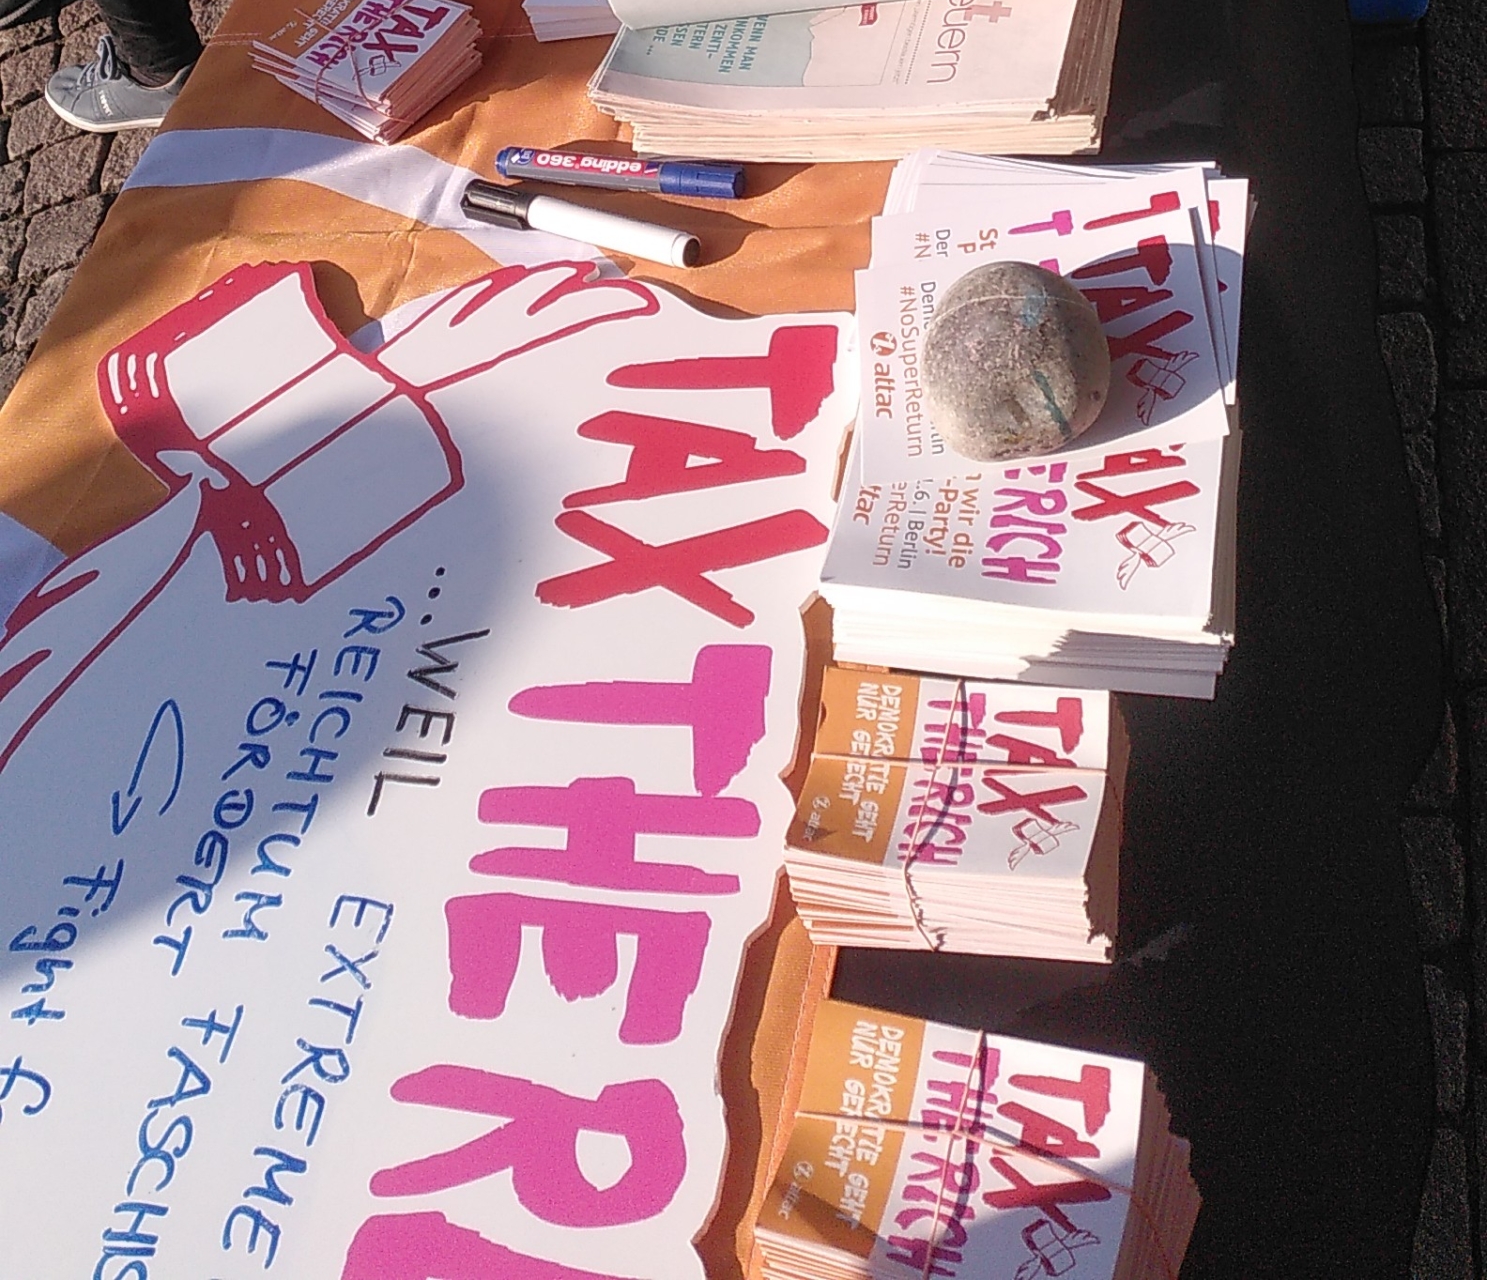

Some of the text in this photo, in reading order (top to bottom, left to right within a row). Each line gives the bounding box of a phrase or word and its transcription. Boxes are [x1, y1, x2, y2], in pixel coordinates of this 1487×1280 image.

[362, 4, 451, 63] TAX
[706, 23, 728, 60] ZENTI-
[717, 17, 749, 75] INKOMMEN
[738, 46, 757, 72] MAN
[536, 154, 643, 173] edding 360
[873, 363, 898, 419] attac
[899, 286, 924, 458] #NoSuperReturn
[535, 324, 840, 629] TAX
[897, 521, 926, 570] Berlin
[947, 487, 981, 570] wir die
[854, 681, 881, 722] NUR
[222, 595, 405, 946] REICHTUM
[976, 696, 1088, 826] TAX
[445, 644, 774, 1046] THE
[851, 799, 879, 844] GEHT
[11, 858, 126, 1025] Fight
[848, 1019, 879, 1071] NUR
[221, 894, 396, 1271] EXTREME
[982, 1064, 1113, 1233] TAX
[834, 1173, 870, 1231] GEHT
